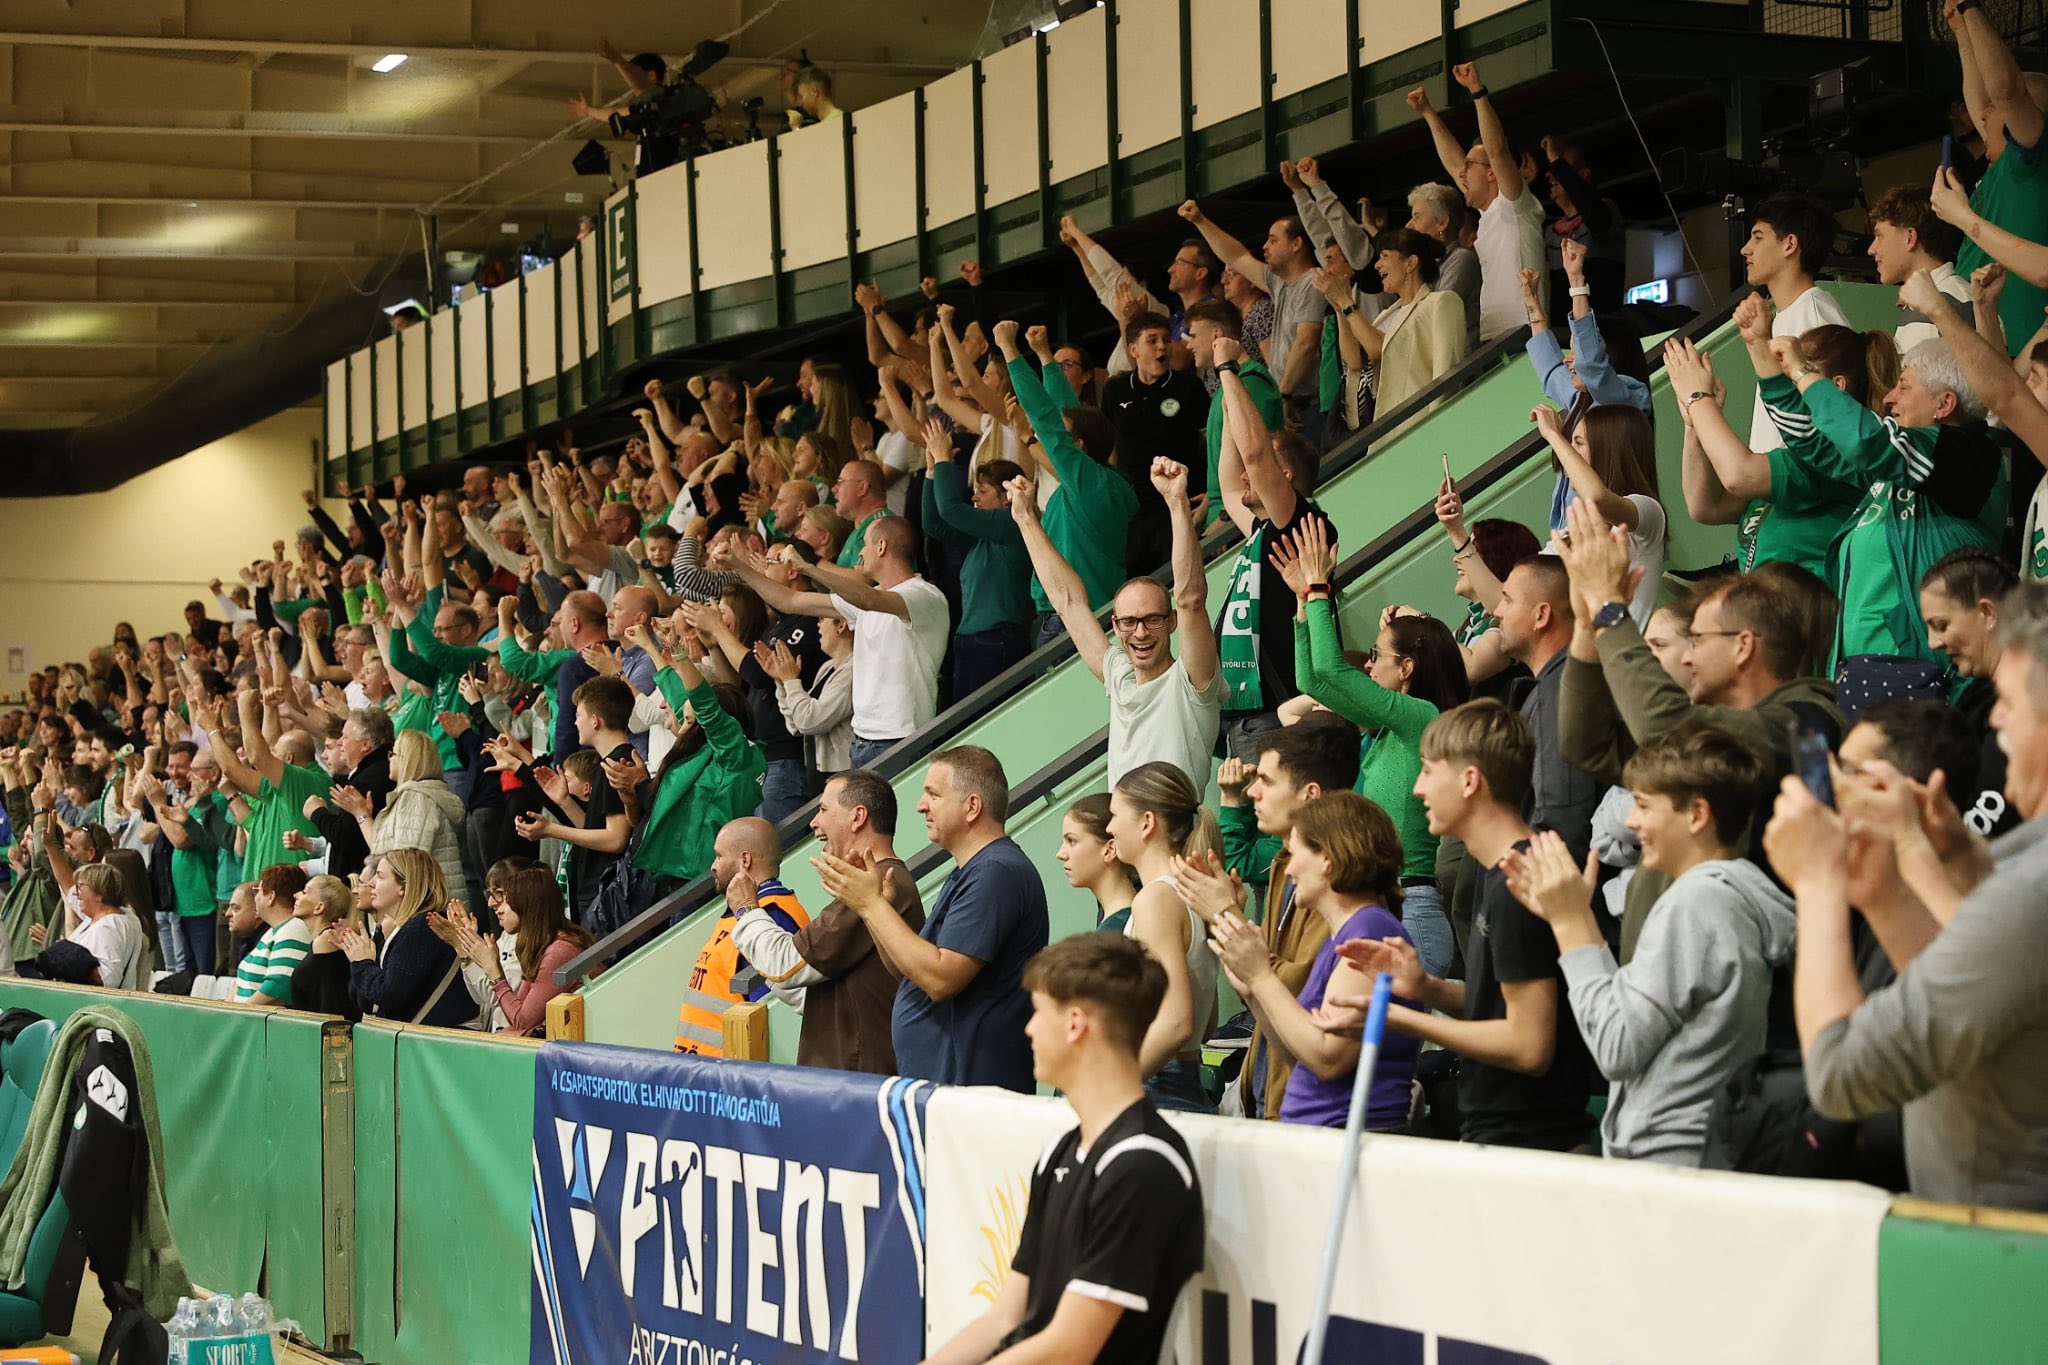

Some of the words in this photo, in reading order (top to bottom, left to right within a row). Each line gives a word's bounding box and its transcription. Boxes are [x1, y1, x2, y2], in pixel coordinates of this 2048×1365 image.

[615, 208, 626, 270] E
[787, 628, 805, 645] 9
[1241, 660, 1256, 669] ETO
[551, 1068, 558, 1091] A
[560, 1070, 638, 1105] CSAPATSPORTOK
[640, 1083, 707, 1114] ELHIVATOTT
[709, 1089, 781, 1128] TÁMOGATÓJA
[206, 1343, 248, 1365] SPORT
